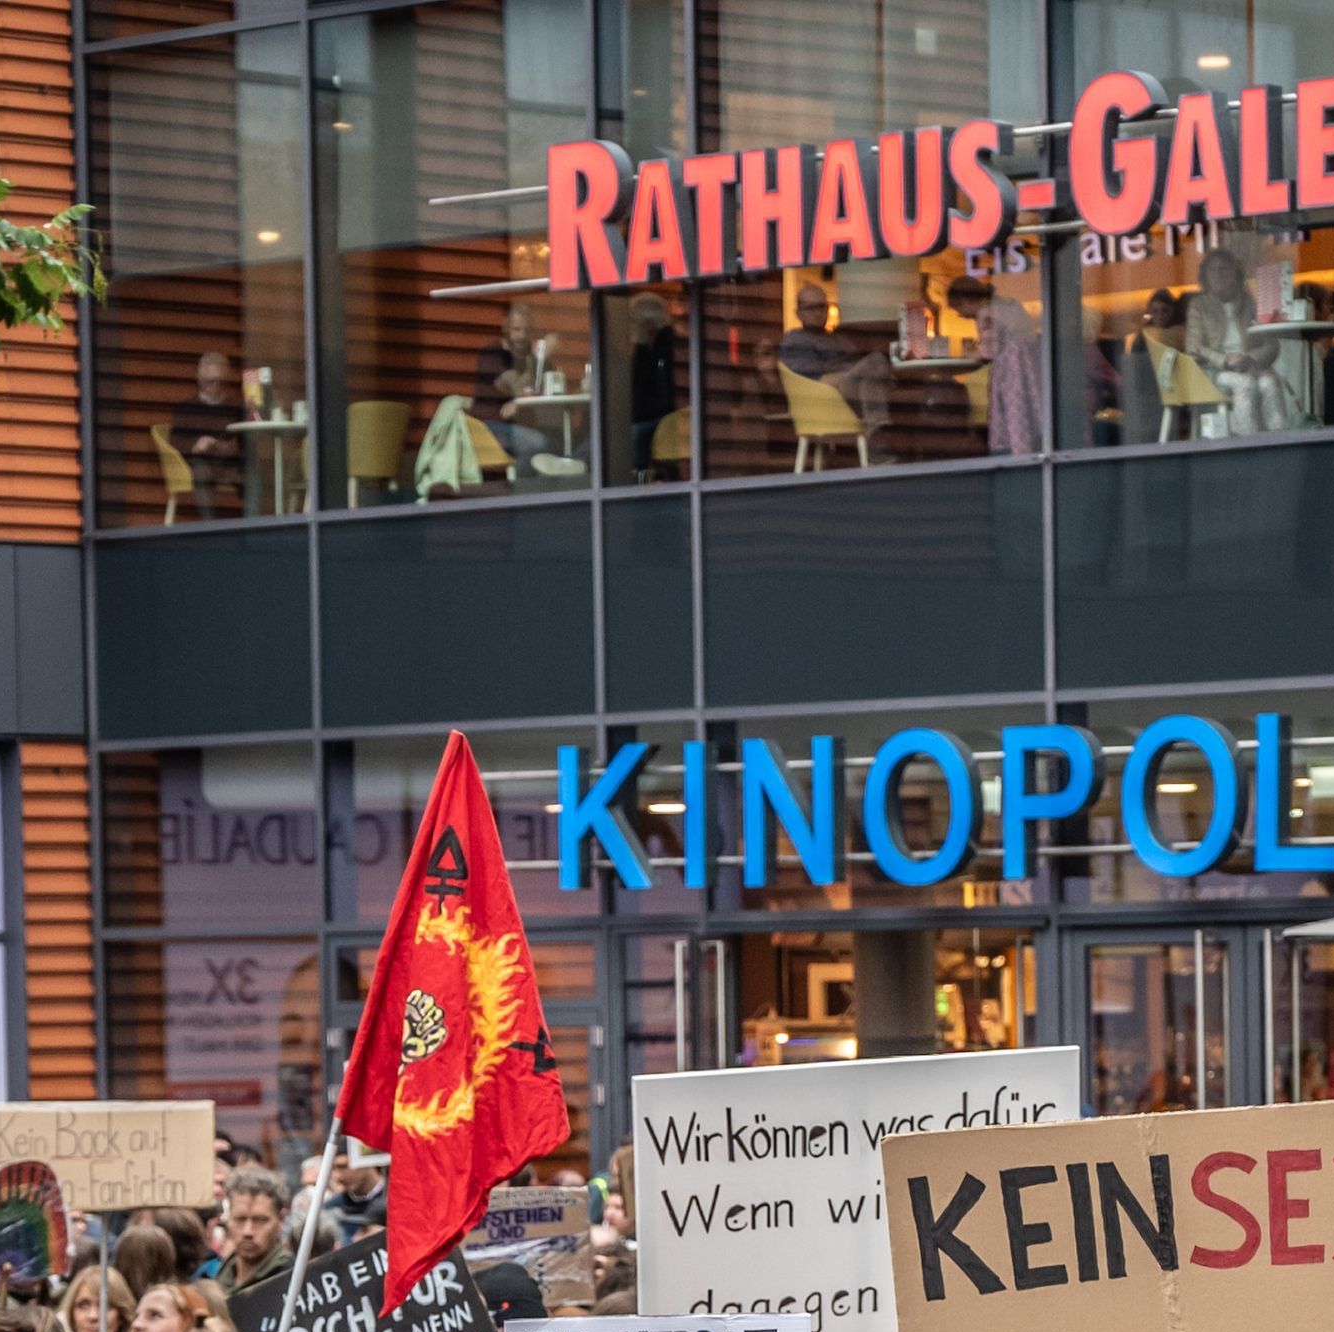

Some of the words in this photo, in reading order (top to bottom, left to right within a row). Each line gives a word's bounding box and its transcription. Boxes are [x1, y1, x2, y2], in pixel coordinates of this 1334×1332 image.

[54, 1108, 120, 1159] Bock
[128, 1109, 173, 1157] auf
[725, 1106, 849, 1163] können
[487, 1224, 526, 1240] UND
[661, 1183, 794, 1237] Wenn
[907, 1153, 1179, 1301] KEIN
